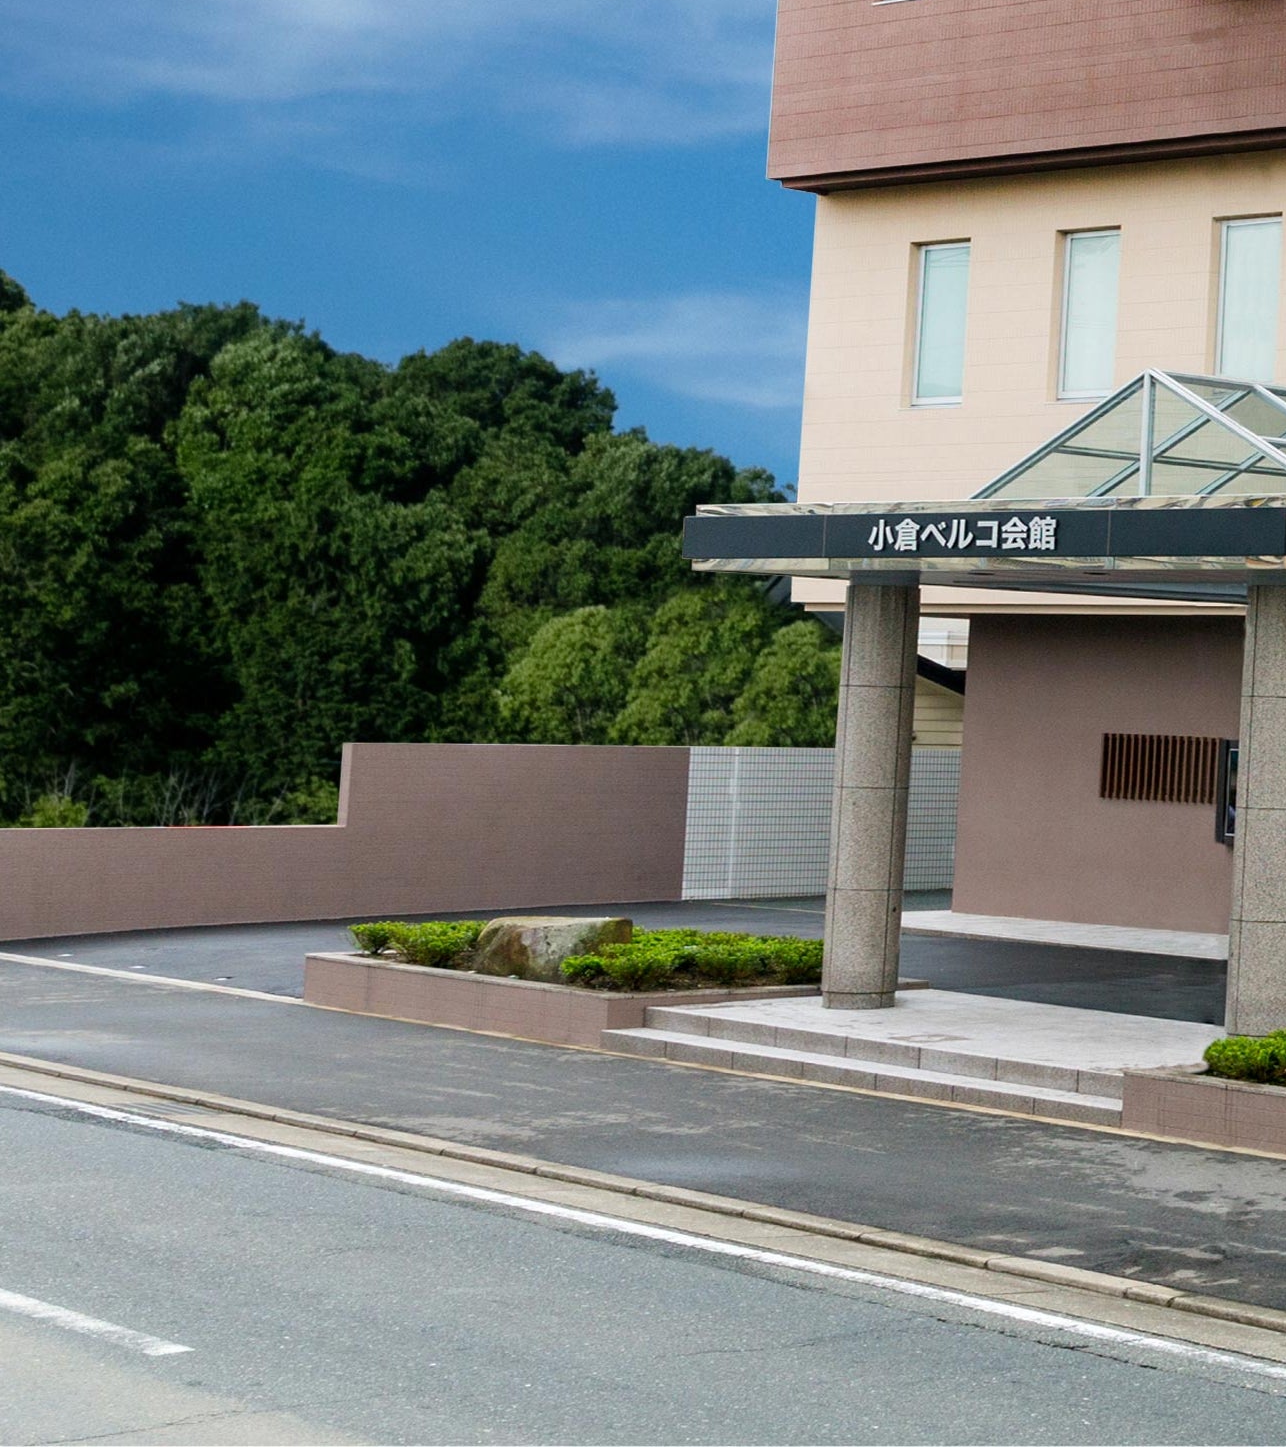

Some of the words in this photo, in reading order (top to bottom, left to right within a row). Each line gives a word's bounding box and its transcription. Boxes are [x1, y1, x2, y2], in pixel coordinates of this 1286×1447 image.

[868, 516, 1056, 551] 小倉ベルコ会館
